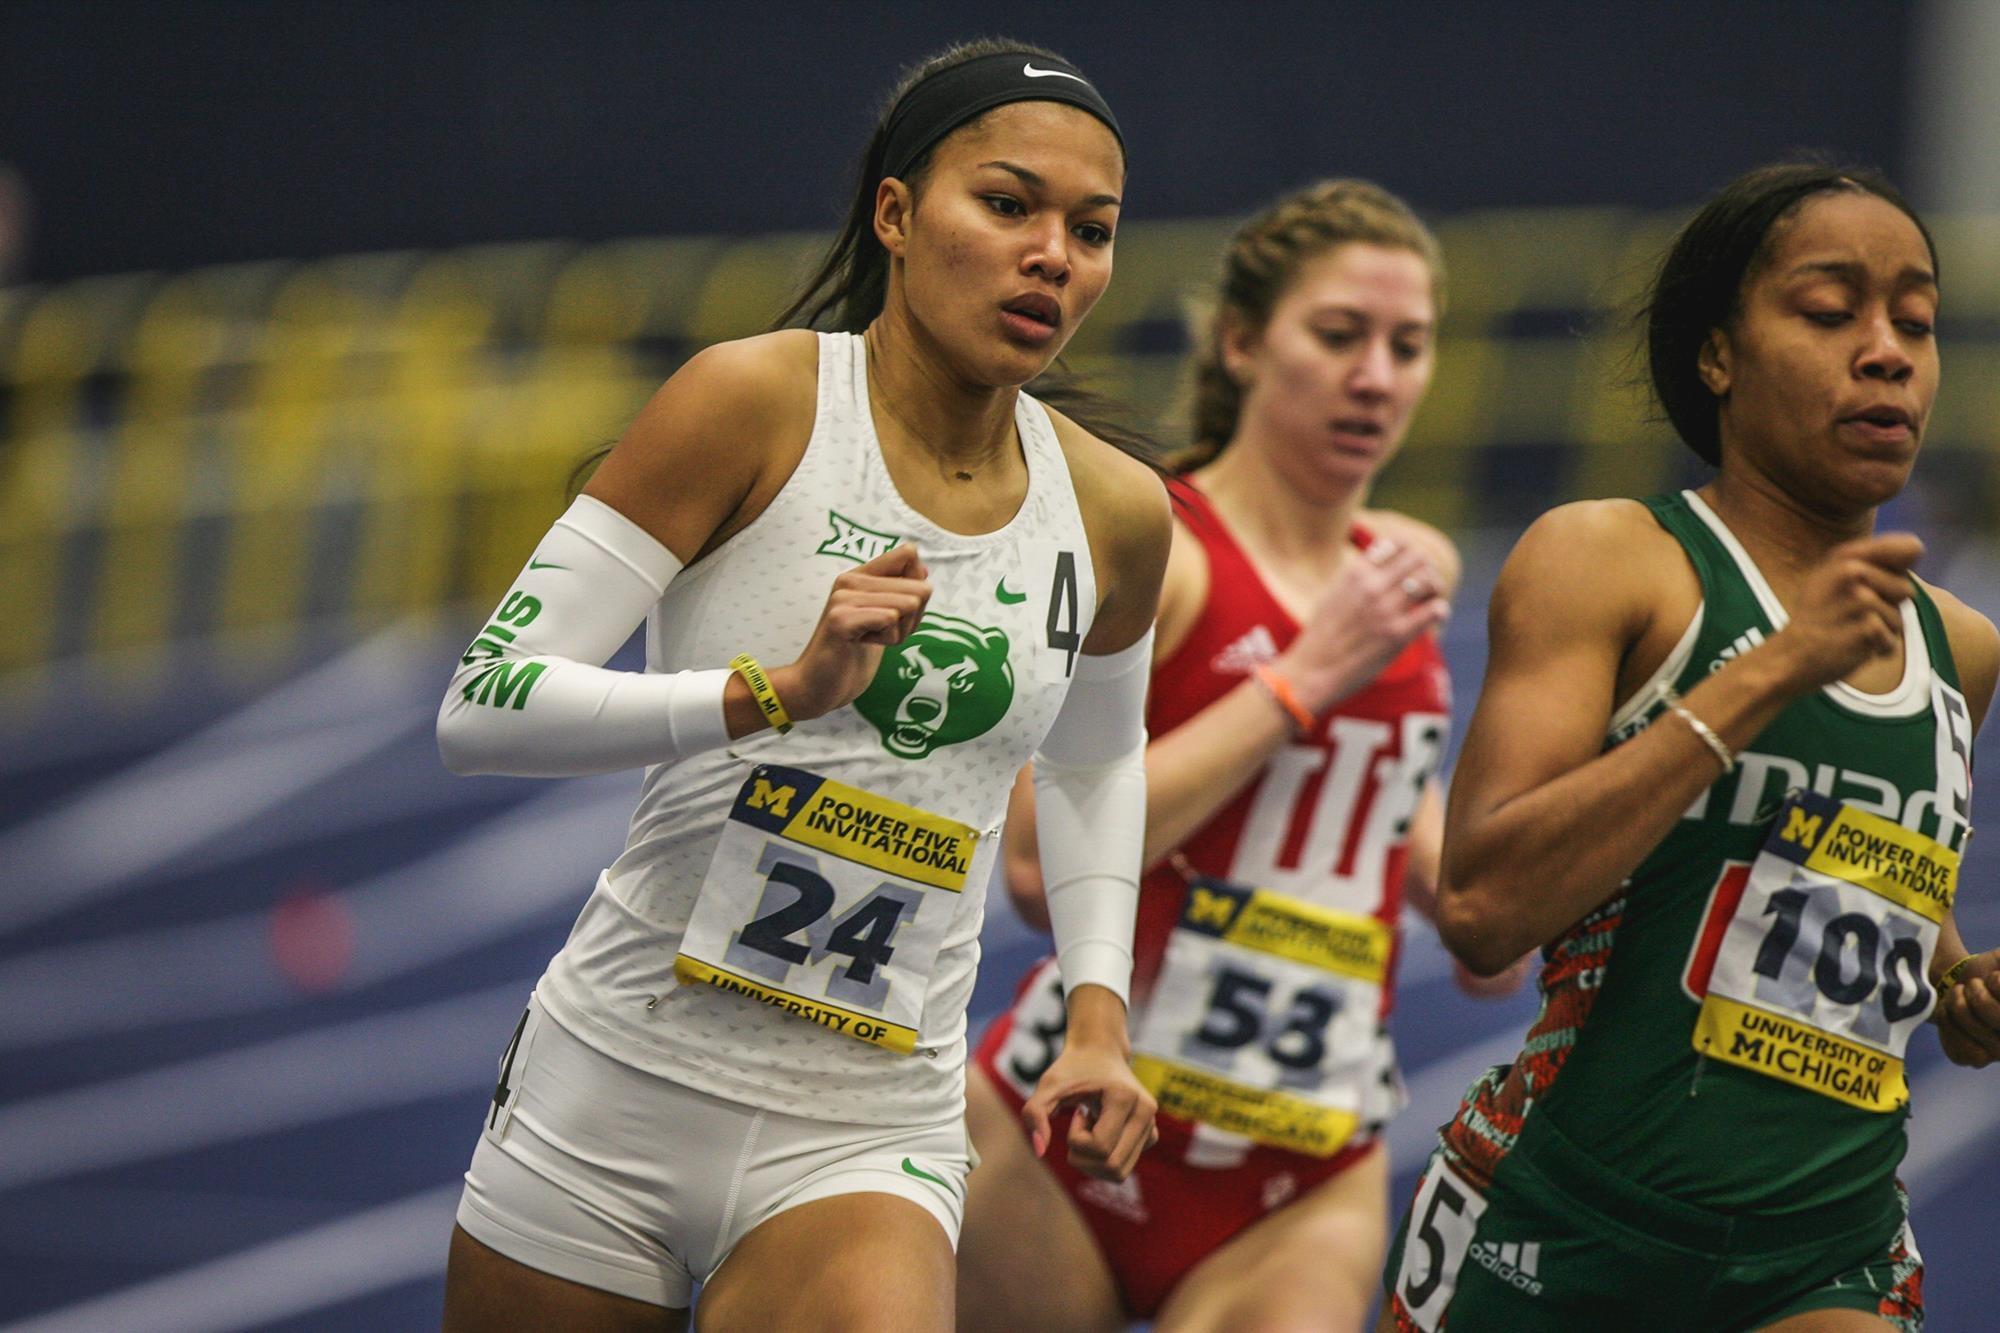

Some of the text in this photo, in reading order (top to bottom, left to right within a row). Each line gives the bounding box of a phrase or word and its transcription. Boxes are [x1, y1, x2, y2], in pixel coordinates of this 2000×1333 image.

[1046, 551, 1081, 678] 4
[761, 697, 779, 715] MI
[746, 779, 797, 818] M
[818, 796, 960, 854] POWER FIVE
[1780, 806, 1822, 849] M
[805, 811, 967, 875] INVITATIONAL
[1836, 823, 1950, 885] POWER FIVE
[738, 861, 905, 985] 24
[1753, 887, 1932, 1023] 100
[709, 974, 887, 1041] UNIVERSITY OF
[1010, 980, 1068, 1084] 3
[1198, 967, 1333, 1069] 53
[489, 1007, 531, 1131] 4
[1730, 1032, 1881, 1104] MICHIGAN
[1741, 1012, 1887, 1075] UNIVERSITY OF
[1405, 1176, 1468, 1309] 5
[1469, 1243, 1544, 1296] adidas
